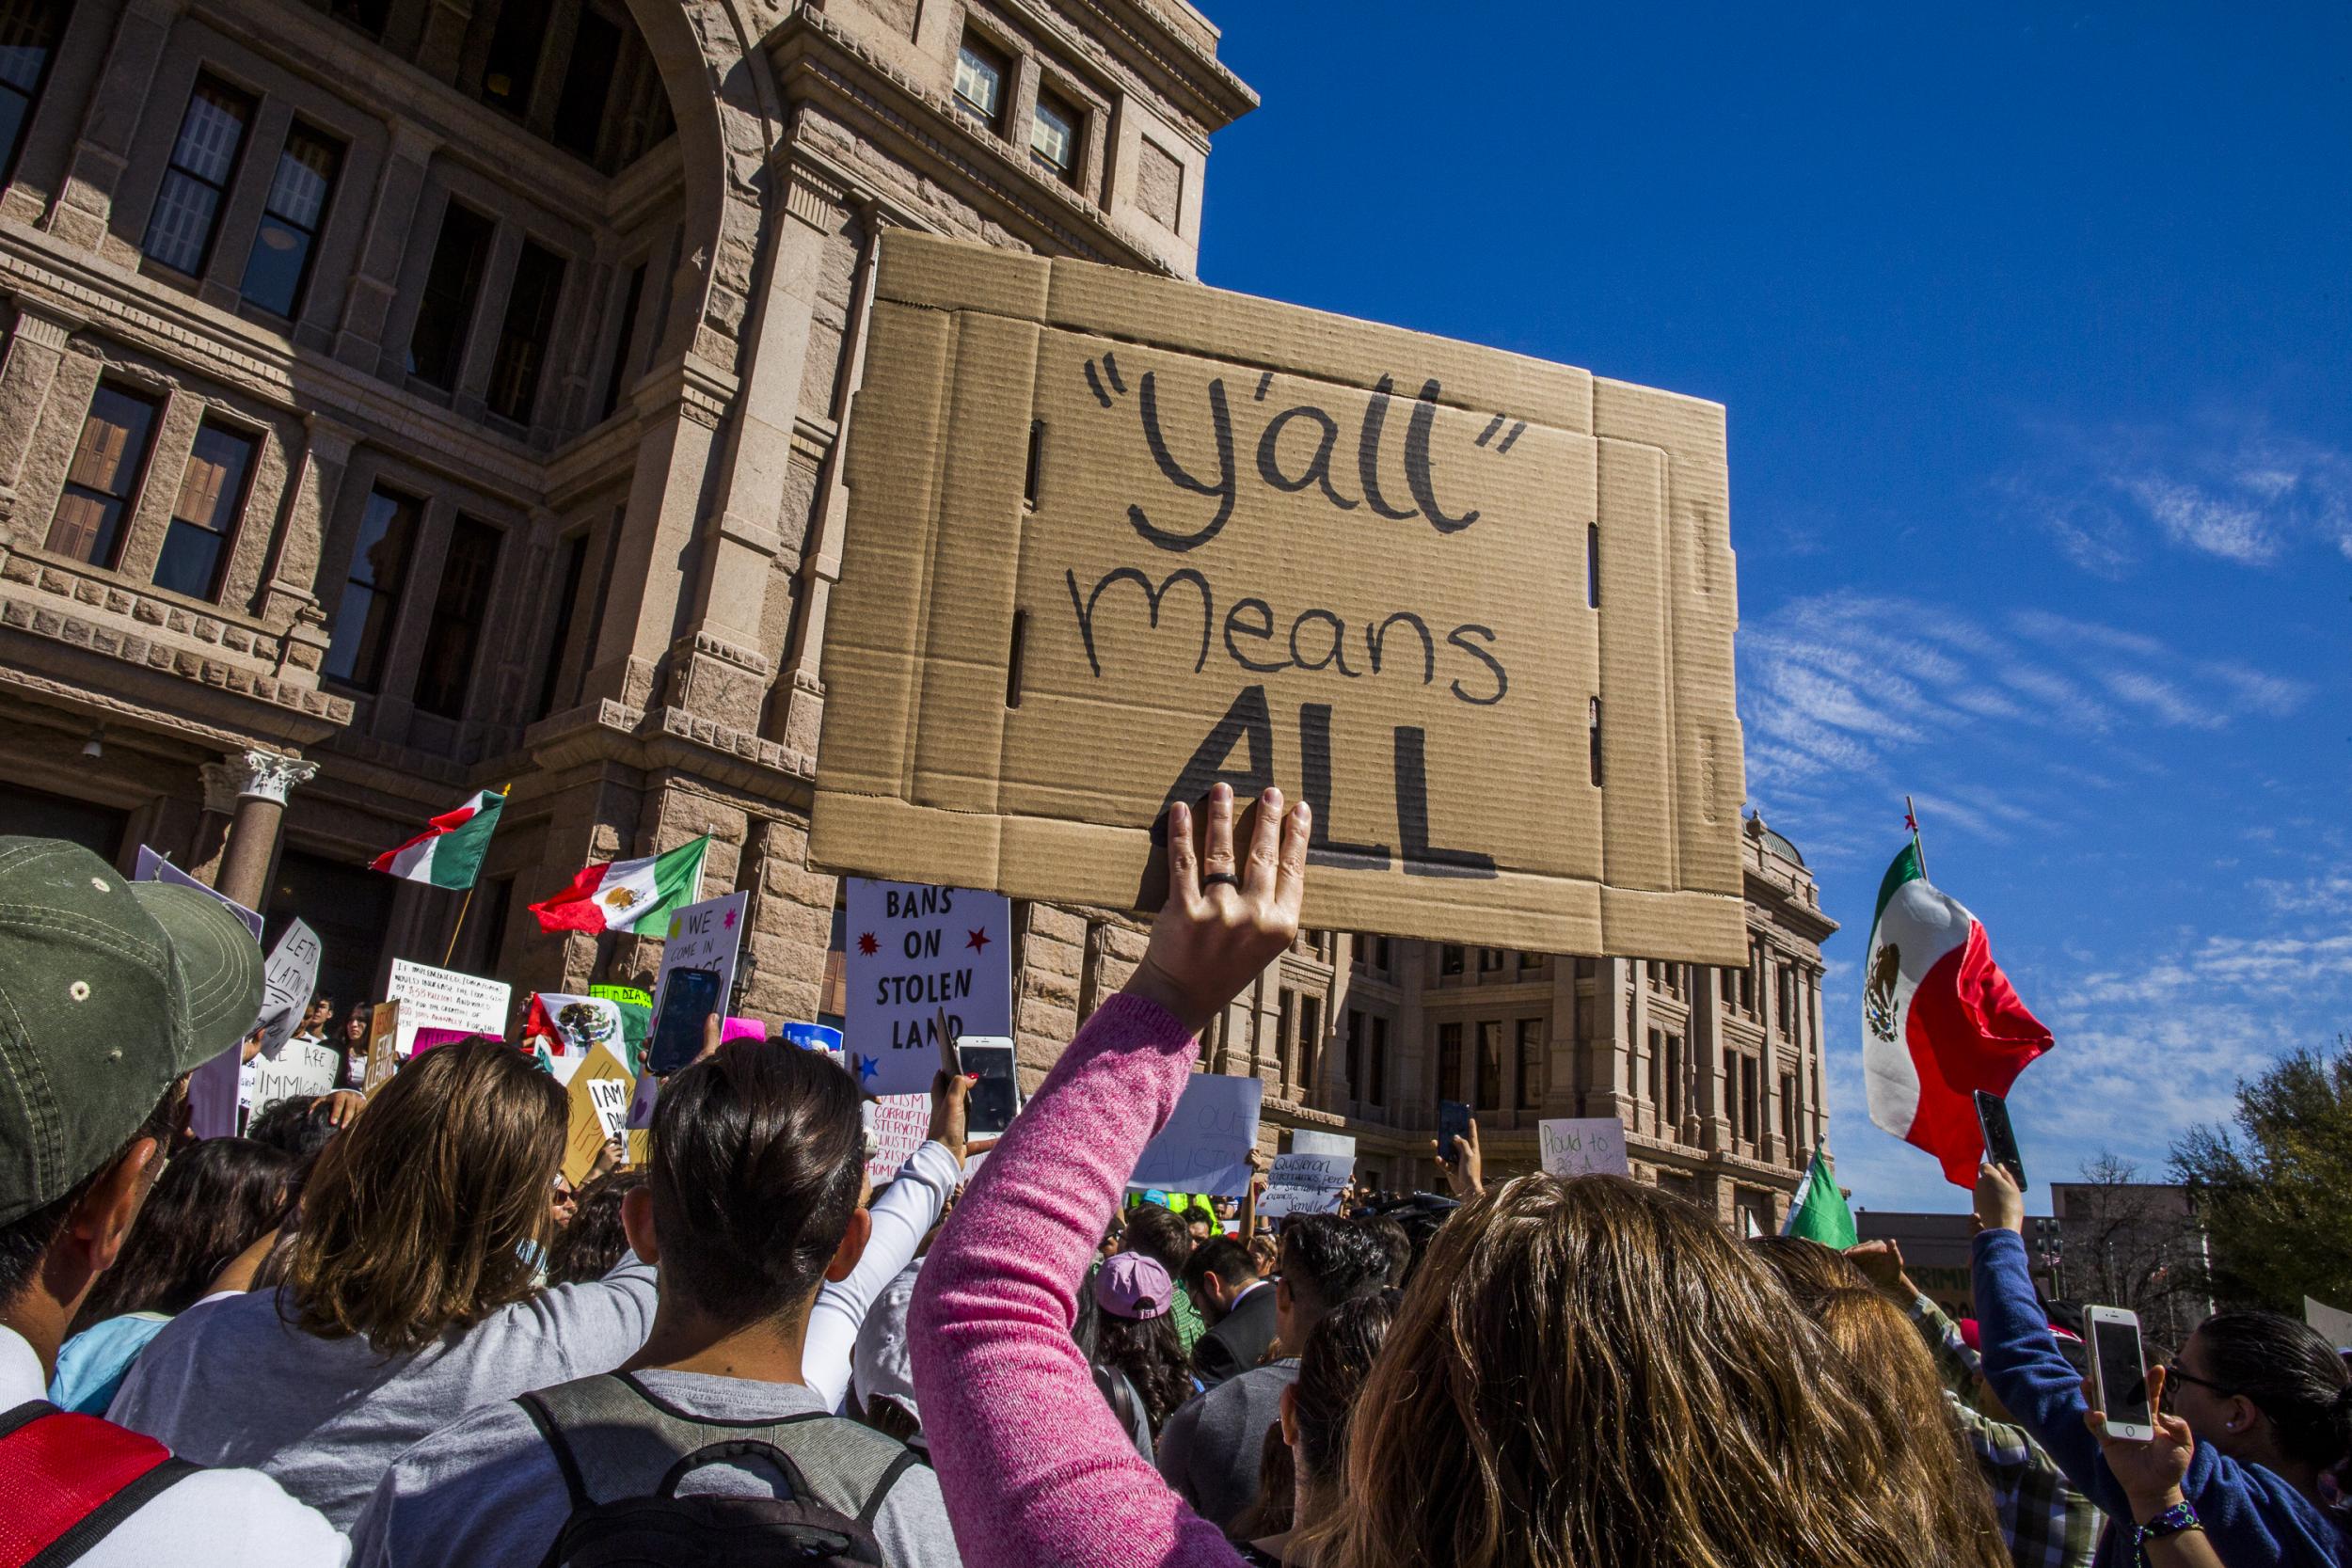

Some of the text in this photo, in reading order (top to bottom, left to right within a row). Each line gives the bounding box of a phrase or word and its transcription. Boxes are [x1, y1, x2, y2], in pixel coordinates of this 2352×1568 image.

[1150, 685, 1499, 879] ALL
[886, 886, 954, 919] BANS
[688, 910, 713, 934] WE
[671, 939, 715, 962] COME IN
[903, 928, 942, 959] ON
[876, 968, 973, 1006] STOLEN
[304, 1046, 326, 1069] ARE
[592, 1085, 625, 1108] I AM
[1588, 1132, 1608, 1152] to
